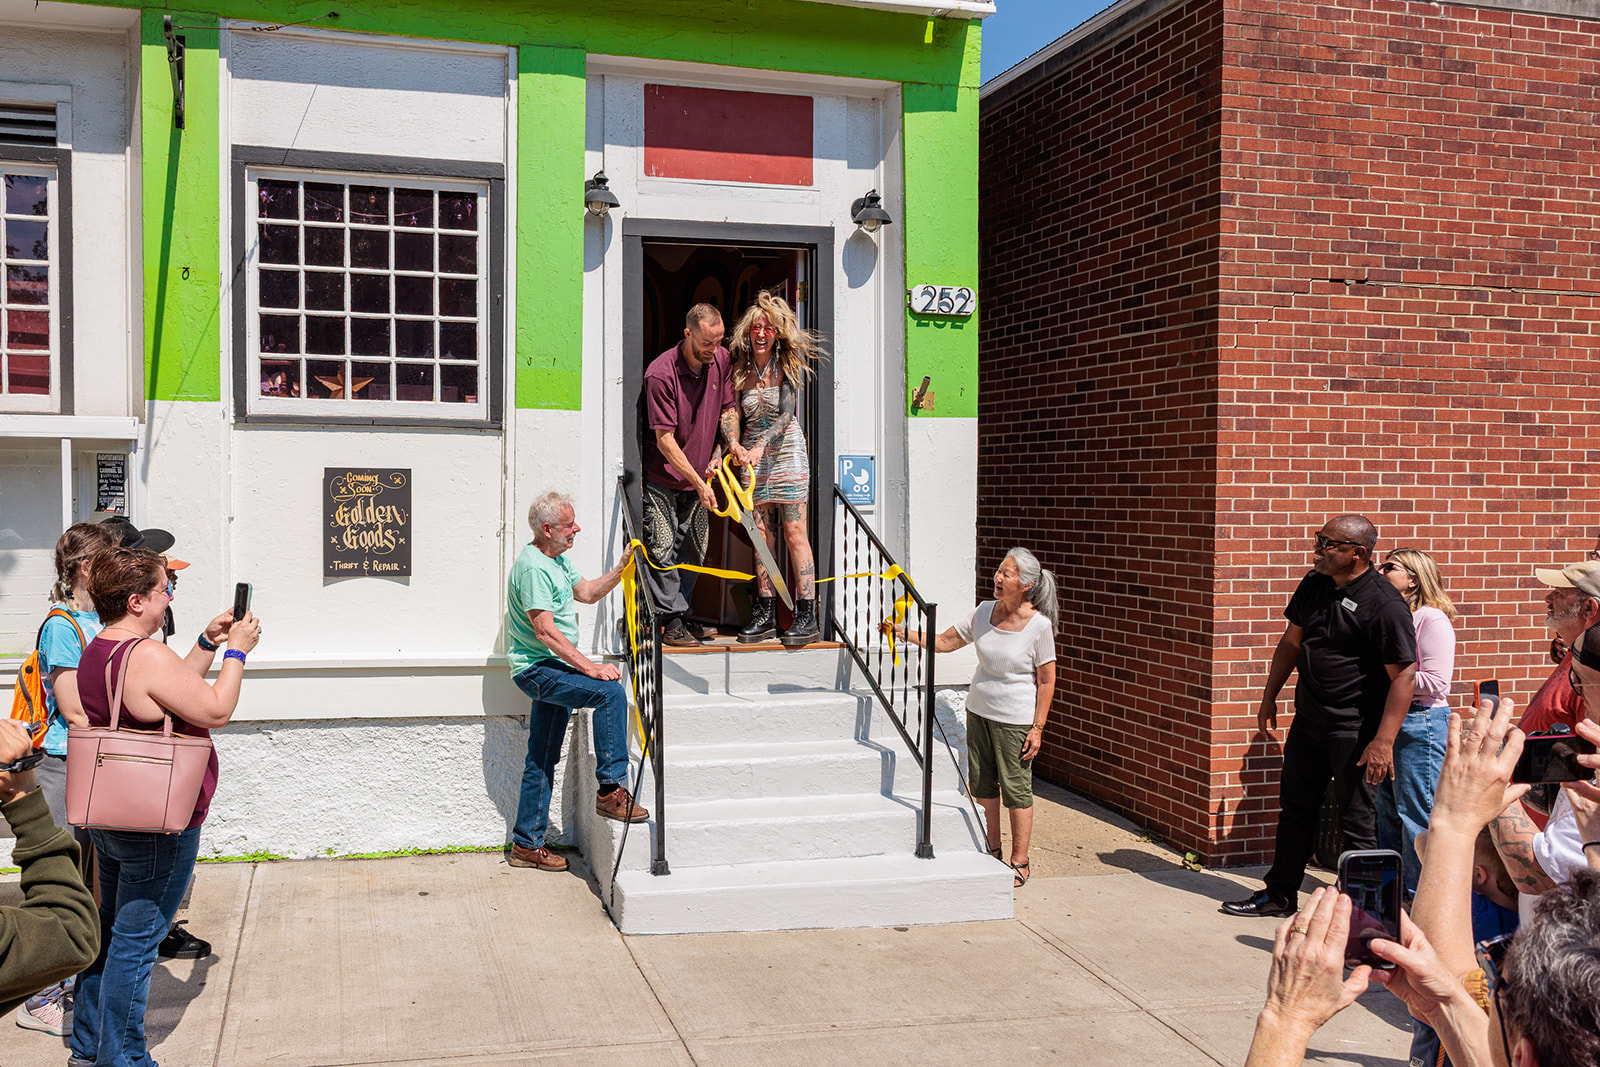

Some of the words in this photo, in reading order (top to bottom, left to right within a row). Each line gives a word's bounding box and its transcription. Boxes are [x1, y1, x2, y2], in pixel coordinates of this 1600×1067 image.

[920, 285, 972, 314] 252
[843, 459, 853, 475] P
[333, 497, 406, 526] Golden
[340, 522, 400, 552] Goods
[333, 560, 359, 571] THRIFT
[363, 558, 370, 573] &
[373, 560, 400, 572] REPAIR
